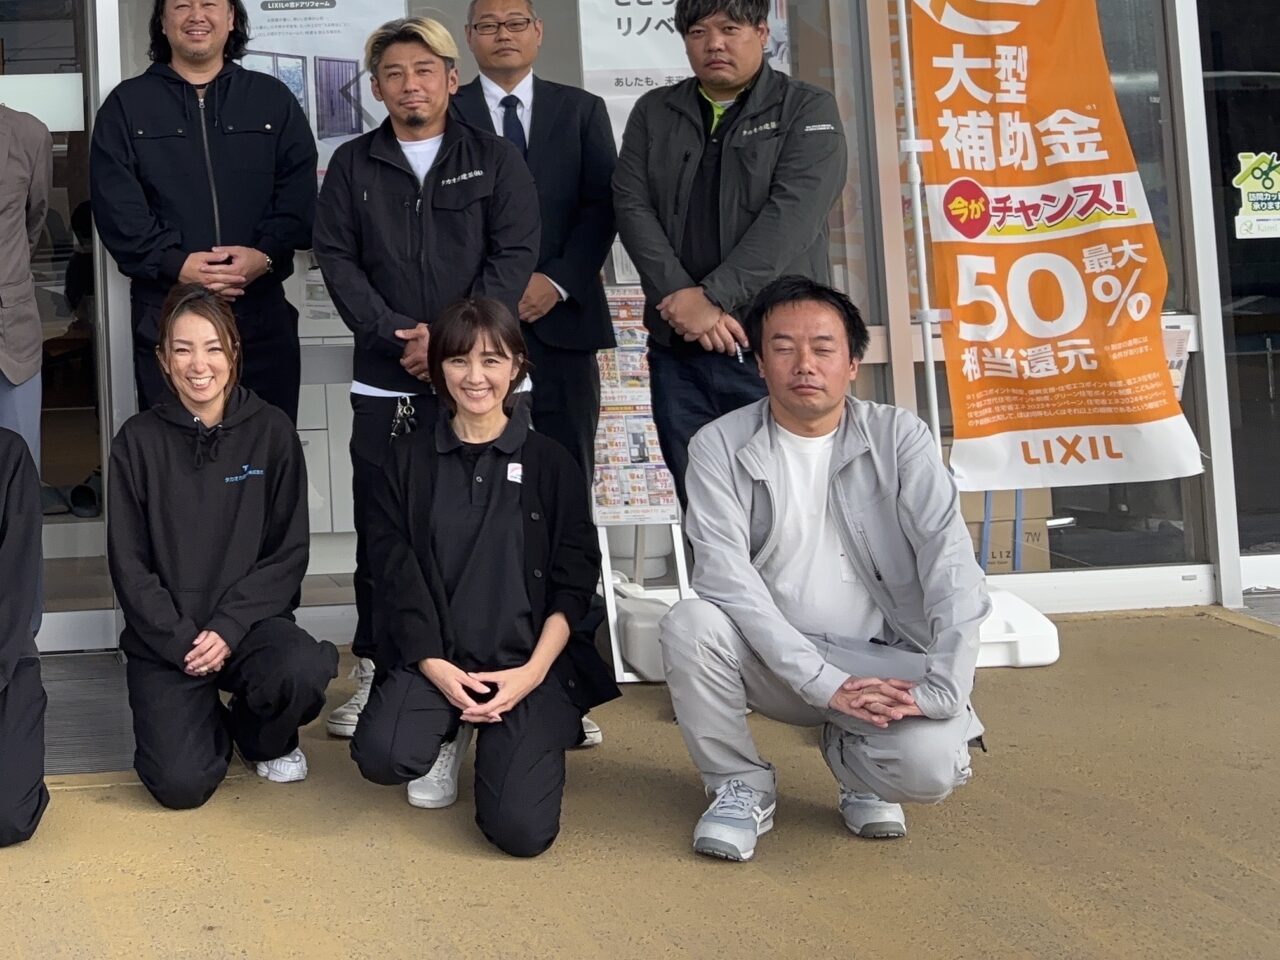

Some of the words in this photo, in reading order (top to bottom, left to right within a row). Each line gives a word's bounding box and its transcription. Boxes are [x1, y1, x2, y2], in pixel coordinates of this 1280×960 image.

[932, 43, 1028, 104] 大型
[937, 108, 1110, 171] 補助金
[1082, 240, 1148, 274] 最大
[961, 338, 1098, 382] 相当還元
[1021, 434, 1124, 466] LIXIL
